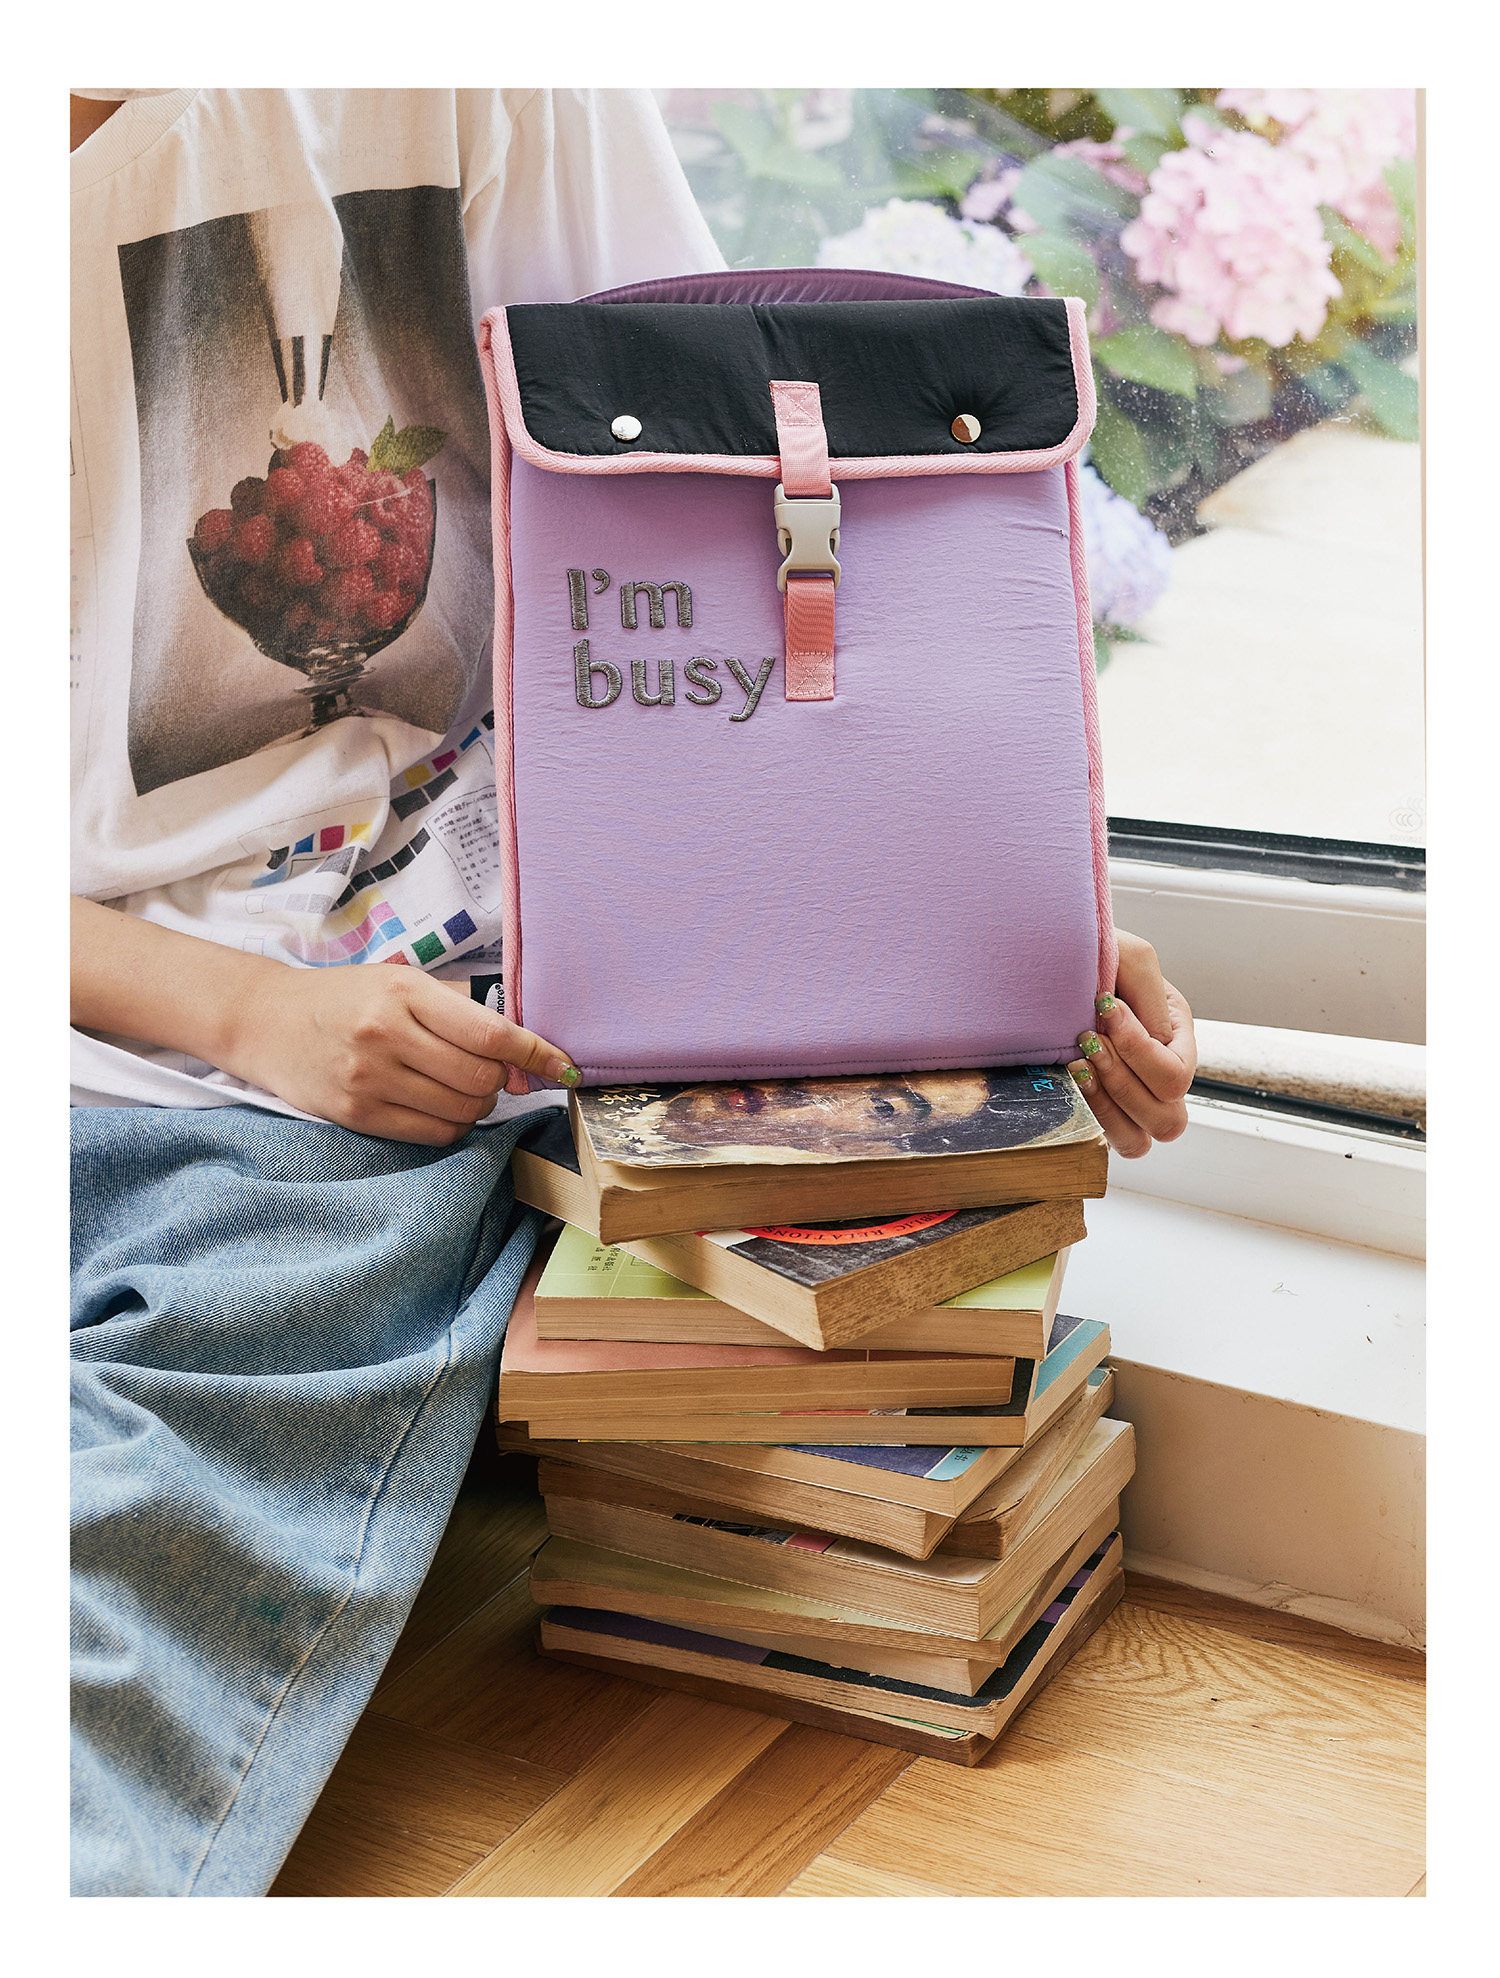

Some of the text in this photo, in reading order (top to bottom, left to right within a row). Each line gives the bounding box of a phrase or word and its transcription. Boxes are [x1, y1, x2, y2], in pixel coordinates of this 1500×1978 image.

[567, 568, 693, 630] I'm
[573, 638, 776, 721] busy
[761, 1211, 944, 1241] UBLIC RELATIONS
